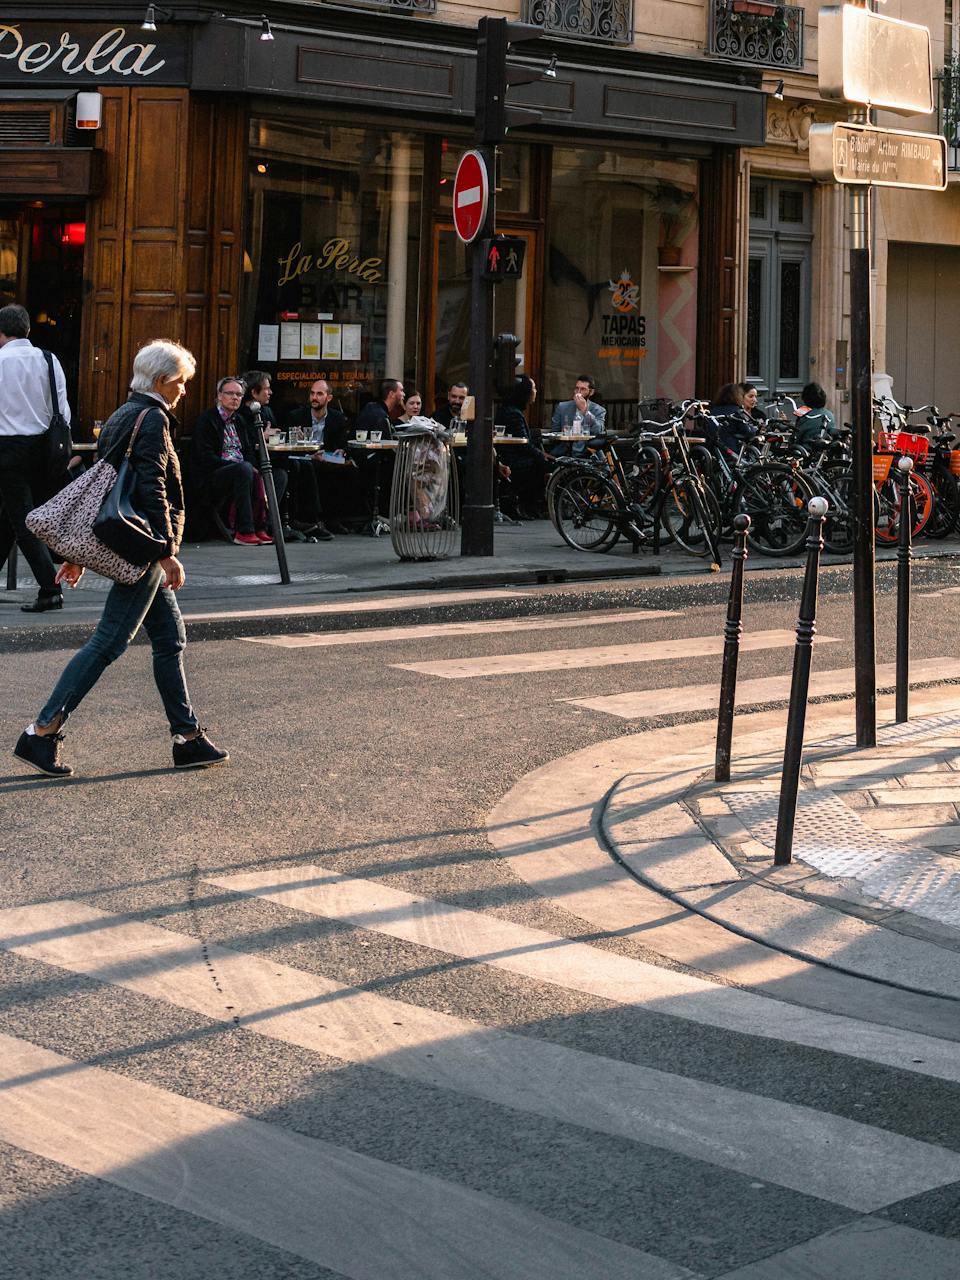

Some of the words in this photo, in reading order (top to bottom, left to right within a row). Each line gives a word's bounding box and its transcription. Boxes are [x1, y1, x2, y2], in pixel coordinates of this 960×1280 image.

[878, 140, 898, 157] Arthur
[901, 142, 931, 160] RIMBAUD
[850, 158, 870, 173] Mairie
[872, 161, 880, 173] du
[278, 242, 313, 286] La
[317, 238, 382, 283] Perla
[300, 282, 363, 309] BAR
[602, 315, 646, 336] TAPAS
[601, 336, 646, 347] MEXICAINS
[277, 372, 327, 380] ESPECIALIDAD
[329, 372, 339, 380] EN
